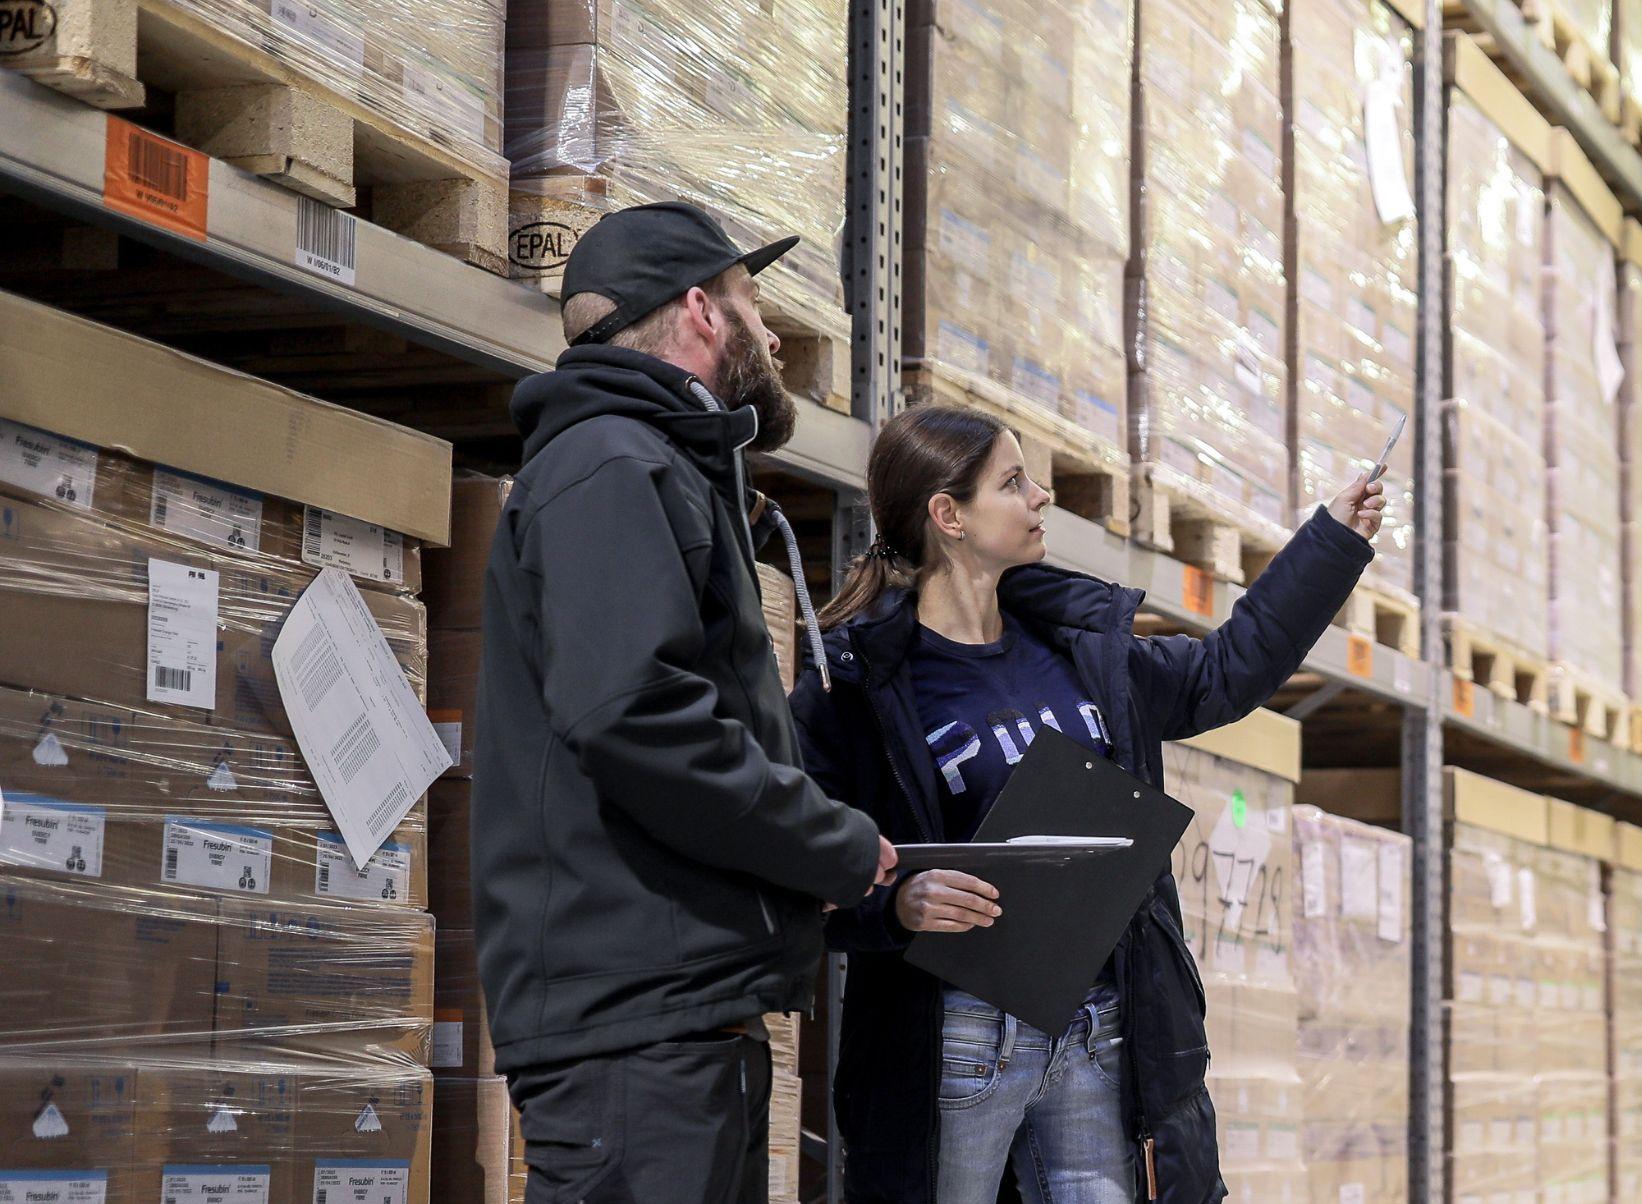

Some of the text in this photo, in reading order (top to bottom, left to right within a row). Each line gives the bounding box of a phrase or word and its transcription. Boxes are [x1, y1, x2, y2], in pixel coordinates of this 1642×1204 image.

[517, 233, 570, 259] EPAL
[203, 839, 233, 852] Fresubin
[348, 1176, 376, 1187] Fresubin
[201, 1184, 230, 1194] Fresubin
